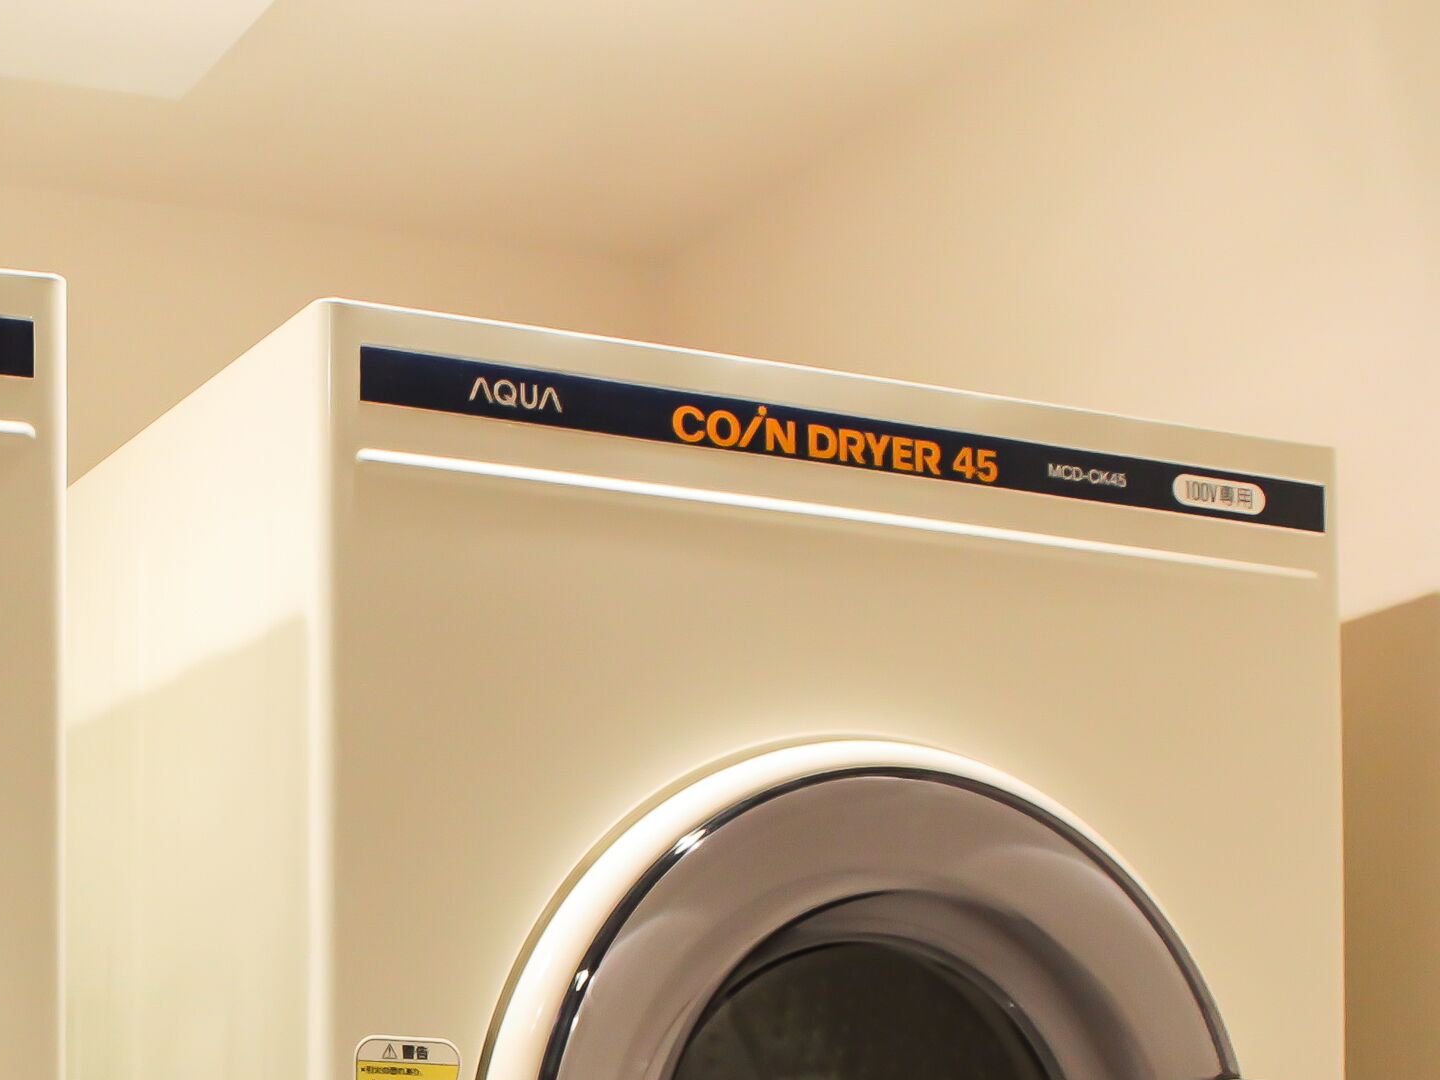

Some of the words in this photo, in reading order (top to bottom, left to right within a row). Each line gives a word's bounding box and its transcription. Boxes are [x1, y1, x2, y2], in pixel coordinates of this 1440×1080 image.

[468, 376, 563, 414] AQUA
[807, 422, 942, 476] DRYER
[951, 447, 999, 484] 45
[1047, 462, 1128, 488] MCD-CK45
